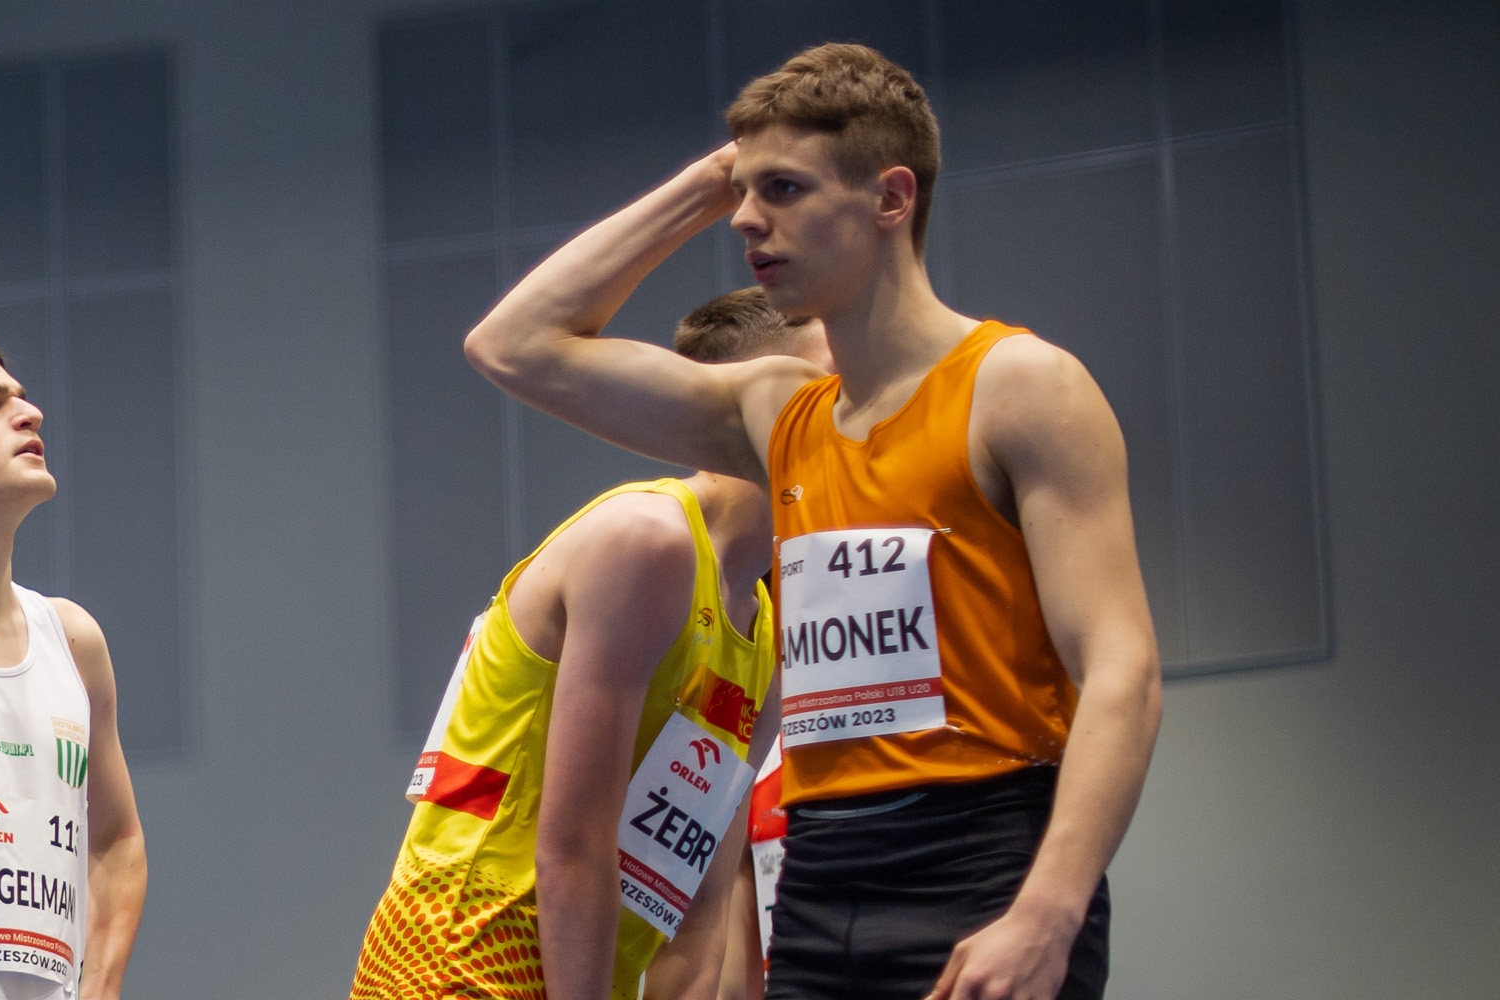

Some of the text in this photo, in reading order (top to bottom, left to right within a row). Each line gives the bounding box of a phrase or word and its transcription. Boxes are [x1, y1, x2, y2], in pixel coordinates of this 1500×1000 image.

[828, 536, 907, 579] 412
[855, 690, 885, 701] Polski
[887, 686, 906, 697] U18
[909, 683, 931, 695] U20
[852, 707, 896, 727] 2023
[669, 760, 712, 795] ORLEN
[623, 858, 645, 884] Halowe
[620, 878, 677, 926] RZESZÓW
